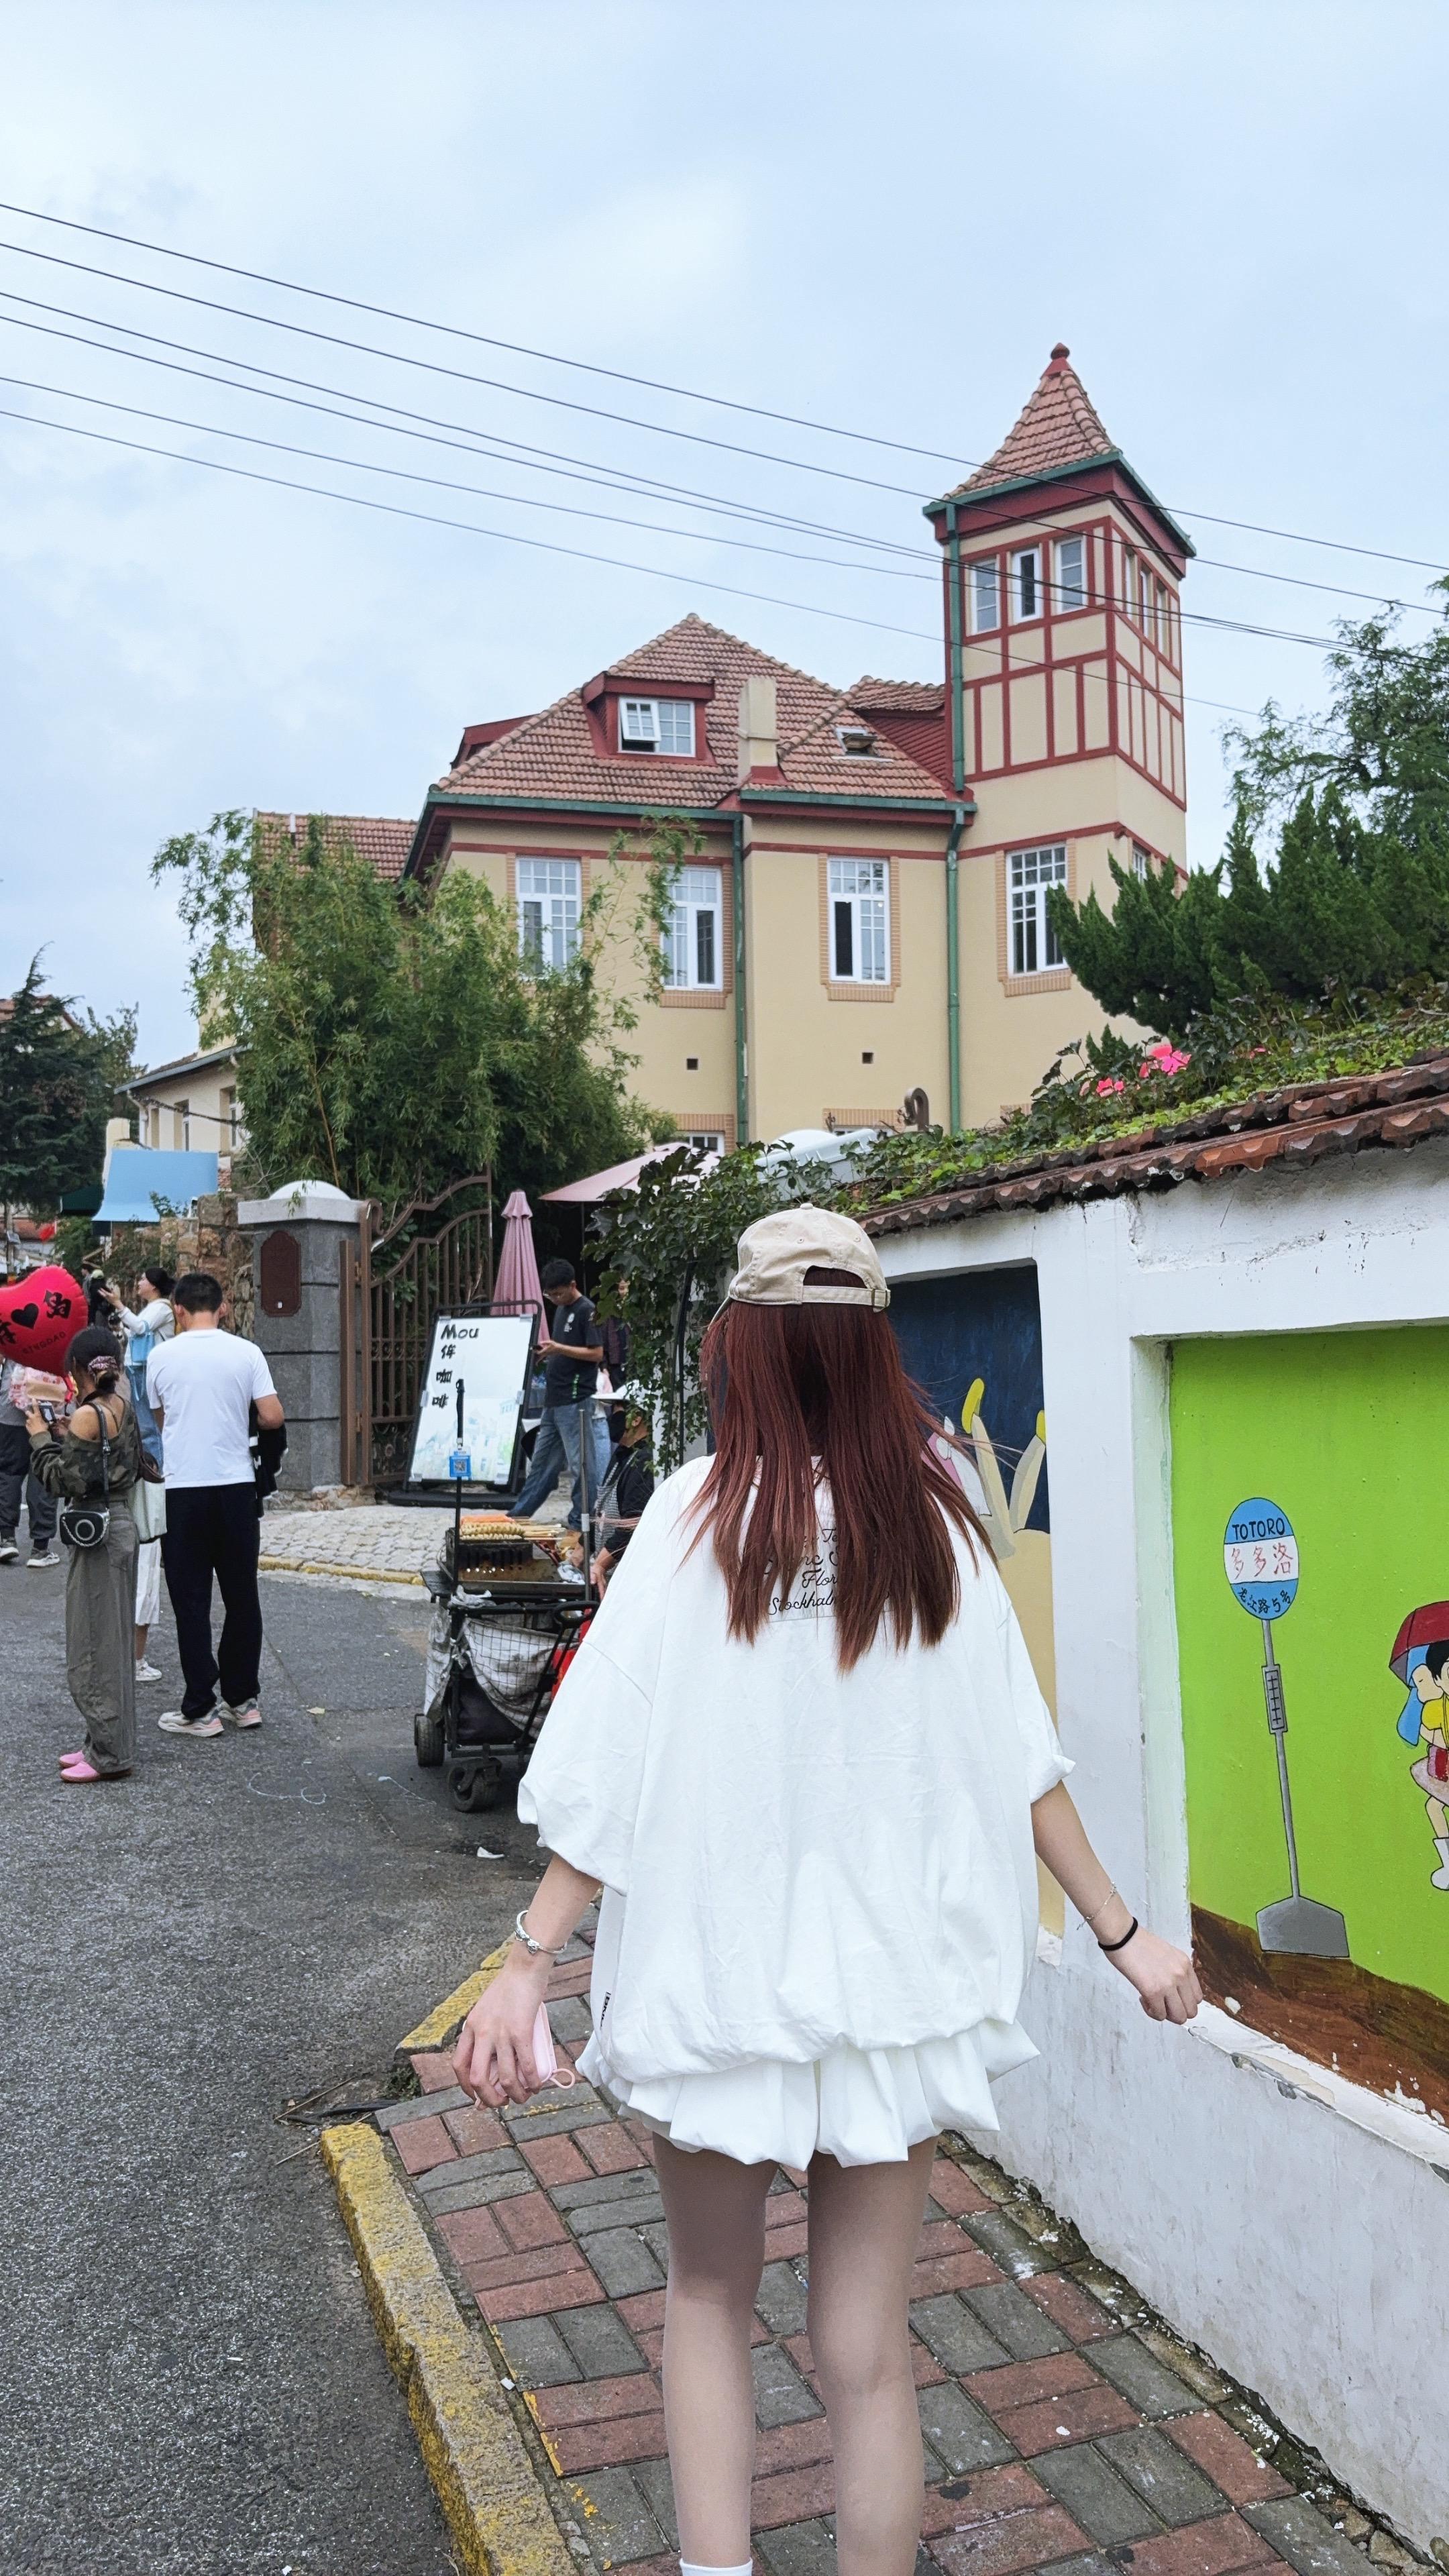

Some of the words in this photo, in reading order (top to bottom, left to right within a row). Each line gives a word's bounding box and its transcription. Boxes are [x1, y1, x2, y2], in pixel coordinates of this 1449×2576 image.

[1232, 1517, 1285, 1540] TOTORO
[1232, 1542, 1293, 1579] 多多洛
[802, 1568, 838, 1589] Flor
